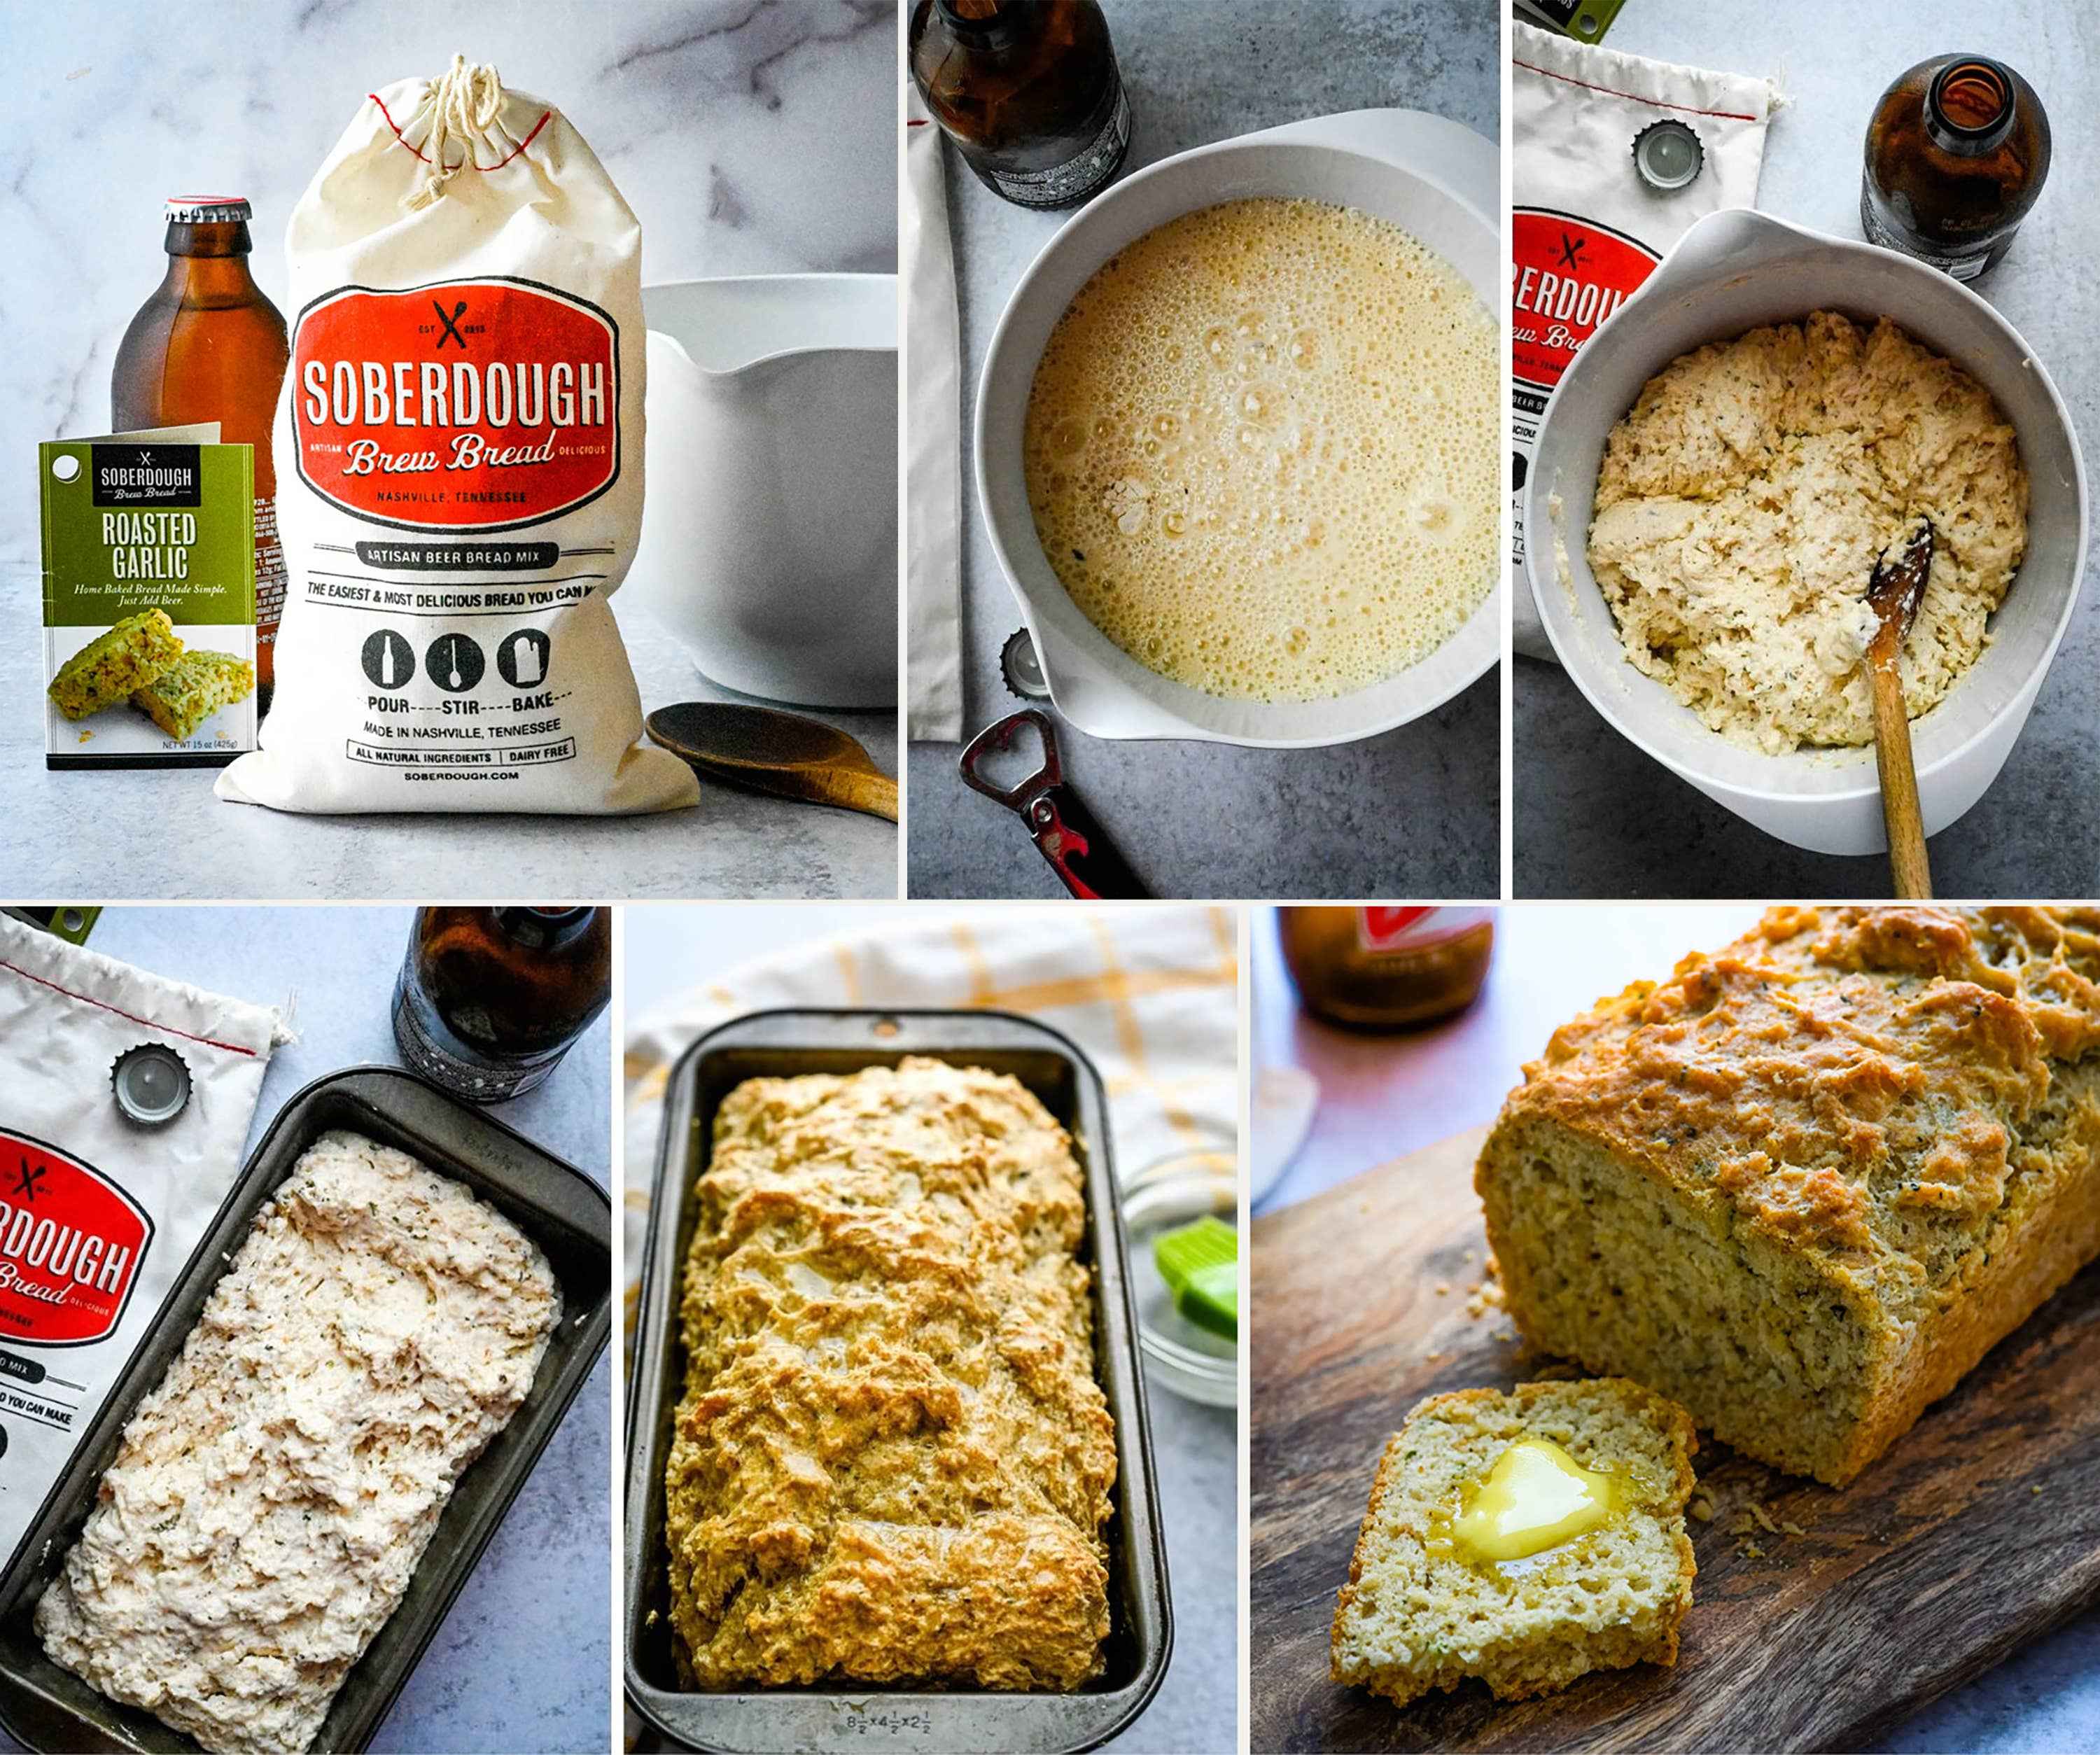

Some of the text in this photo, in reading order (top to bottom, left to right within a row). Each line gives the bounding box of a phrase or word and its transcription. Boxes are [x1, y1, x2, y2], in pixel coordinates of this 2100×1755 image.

[1513, 263, 1634, 330] ERDOU
[303, 361, 604, 426] SOBERDOUGH
[342, 439, 440, 475] Brew
[446, 428, 556, 470] Bread
[559, 445, 606, 456] DELICIOUS
[101, 467, 192, 487] SOBERDOUGH
[144, 486, 177, 498] Bread
[455, 491, 527, 504] TENNESSEE
[102, 512, 197, 545] ROASTED
[113, 546, 188, 580] GARLIC
[368, 550, 539, 564] ARTISAN BEER BREAD MIX
[74, 584, 227, 596] Home Baked Bread Made Simple.
[307, 582, 326, 597] THE
[328, 583, 369, 602] EASIEST
[372, 590, 382, 603] &
[384, 592, 412, 607] MOST
[416, 594, 481, 608] DELICIOUS
[484, 592, 526, 607] BREAD
[528, 590, 554, 606] YOU
[556, 585, 582, 599] CAN
[118, 596, 183, 607] Just Add Beer.
[368, 696, 410, 713] POUR
[442, 700, 479, 714] STIR
[512, 691, 554, 712] BAKE
[363, 718, 561, 741] MADE IN NASHVILLE, TENNESSEE
[162, 741, 177, 750] NET
[179, 740, 191, 750] WT
[193, 740, 203, 750] 15
[214, 740, 238, 750] (425g)
[510, 743, 570, 762] DAIRY FREE
[356, 747, 492, 764] ALL NATURAL INGREDIENTS
[404, 772, 519, 781] SOBERDOUGH.COM
[0, 1261, 75, 1305] Bread
[8, 1361, 28, 1374] MIX
[8, 1394, 27, 1409] YOU
[26, 1402, 45, 1415] CAN
[45, 1407, 72, 1425] MAKE
